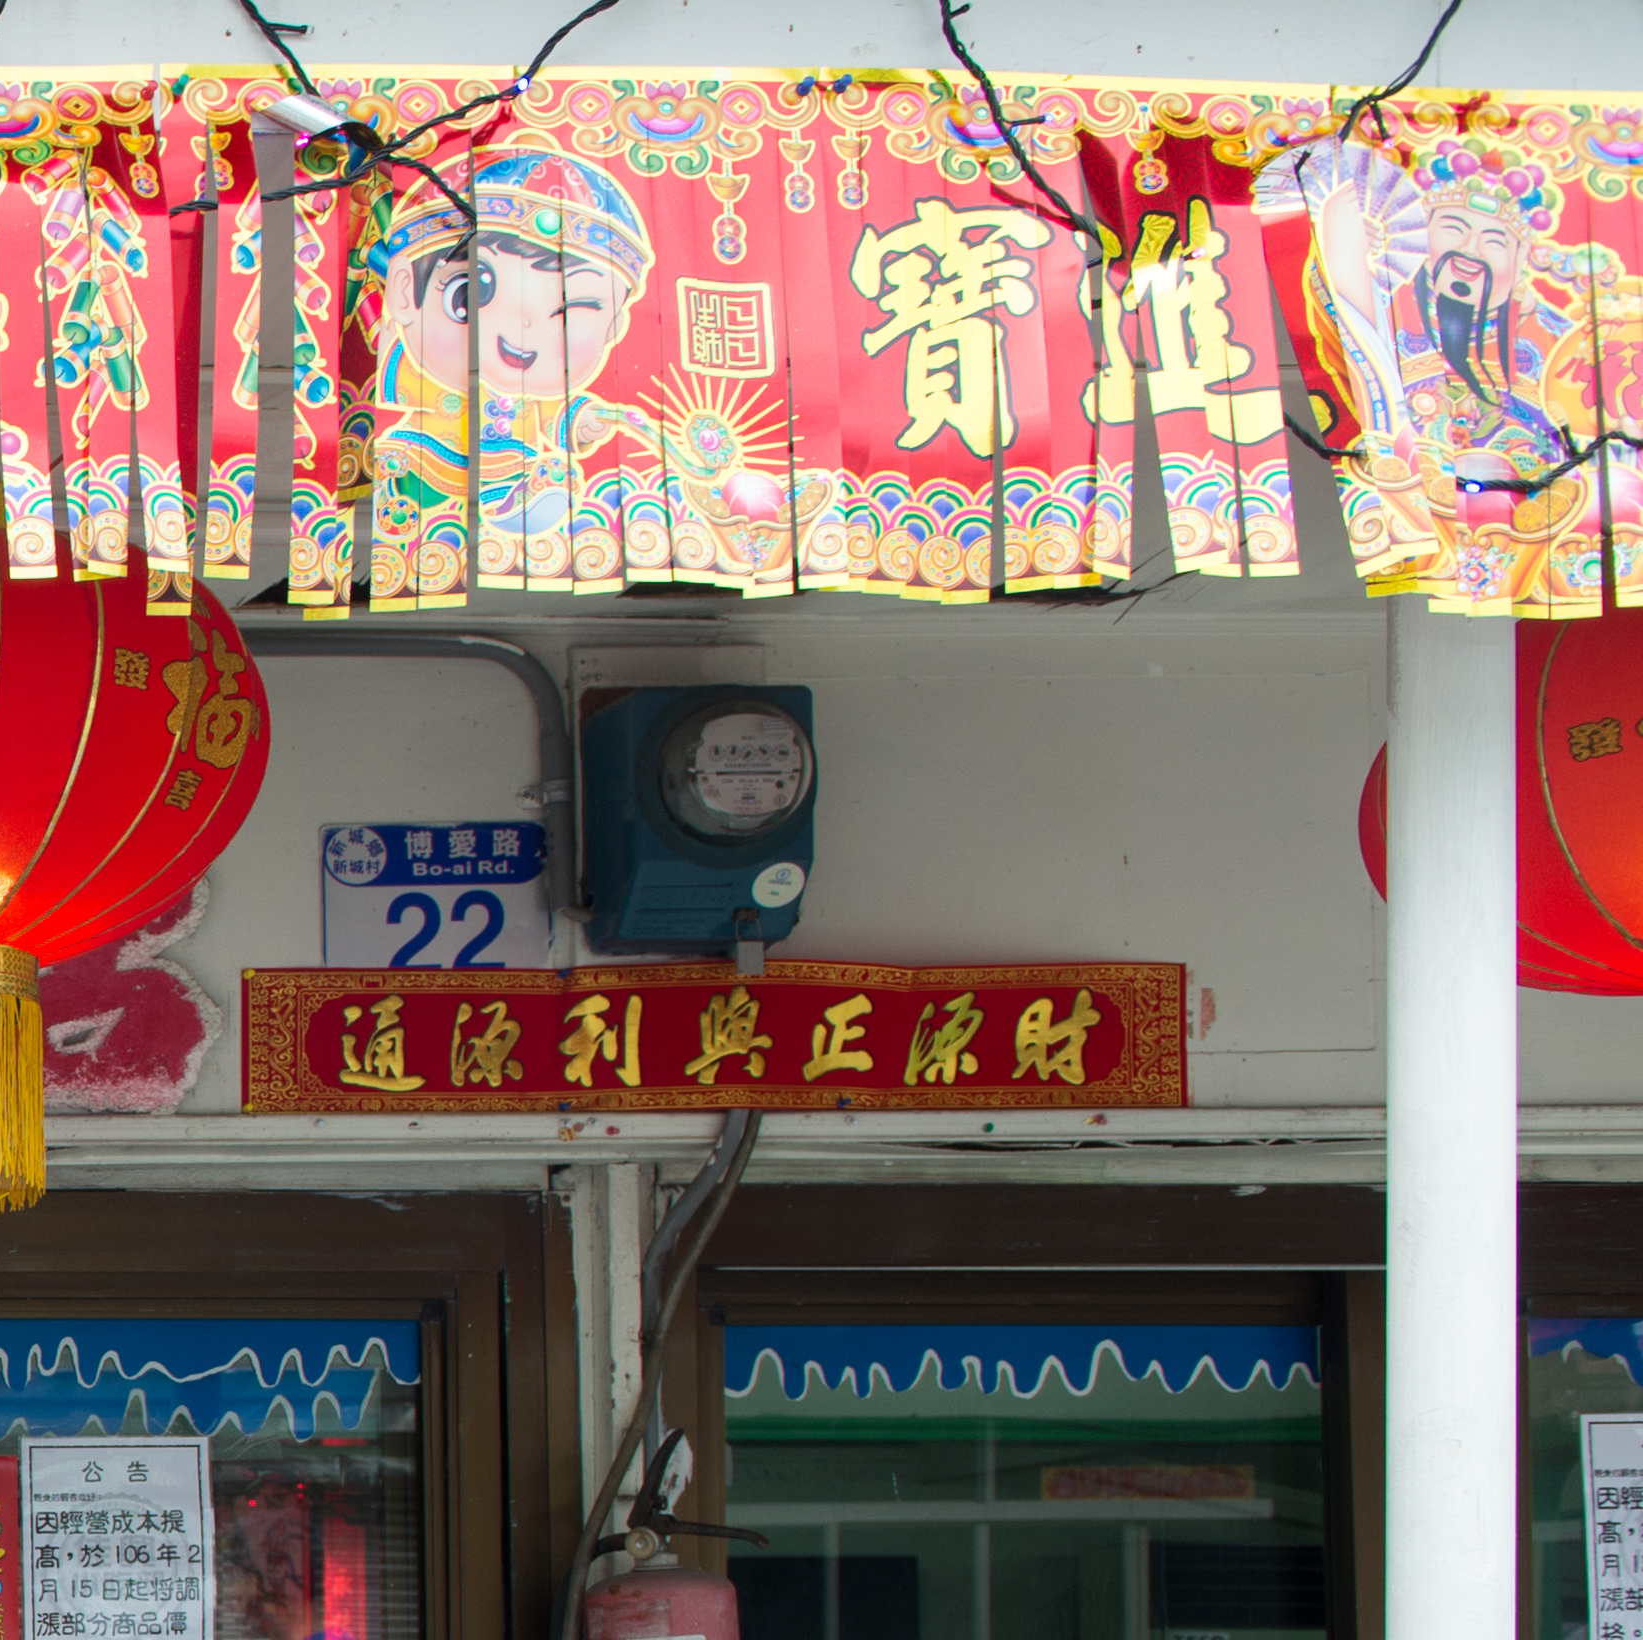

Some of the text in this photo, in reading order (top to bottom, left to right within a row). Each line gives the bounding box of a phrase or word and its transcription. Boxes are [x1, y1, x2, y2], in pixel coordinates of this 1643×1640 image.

[404, 828, 521, 860] 博愛路
[332, 859, 381, 875] 新城村
[413, 860, 516, 877] Bo-ai Rd.
[386, 889, 506, 968] 22
[81, 1461, 150, 1483] 公告
[35, 1510, 186, 1535] 因經營成本提
[115, 1544, 150, 1564] 106
[157, 1543, 182, 1568] 年
[188, 1544, 202, 1564] 2
[38, 1578, 59, 1602] 月
[71, 1579, 94, 1599] 15
[36, 1610, 188, 1637] 漲部分商品價
